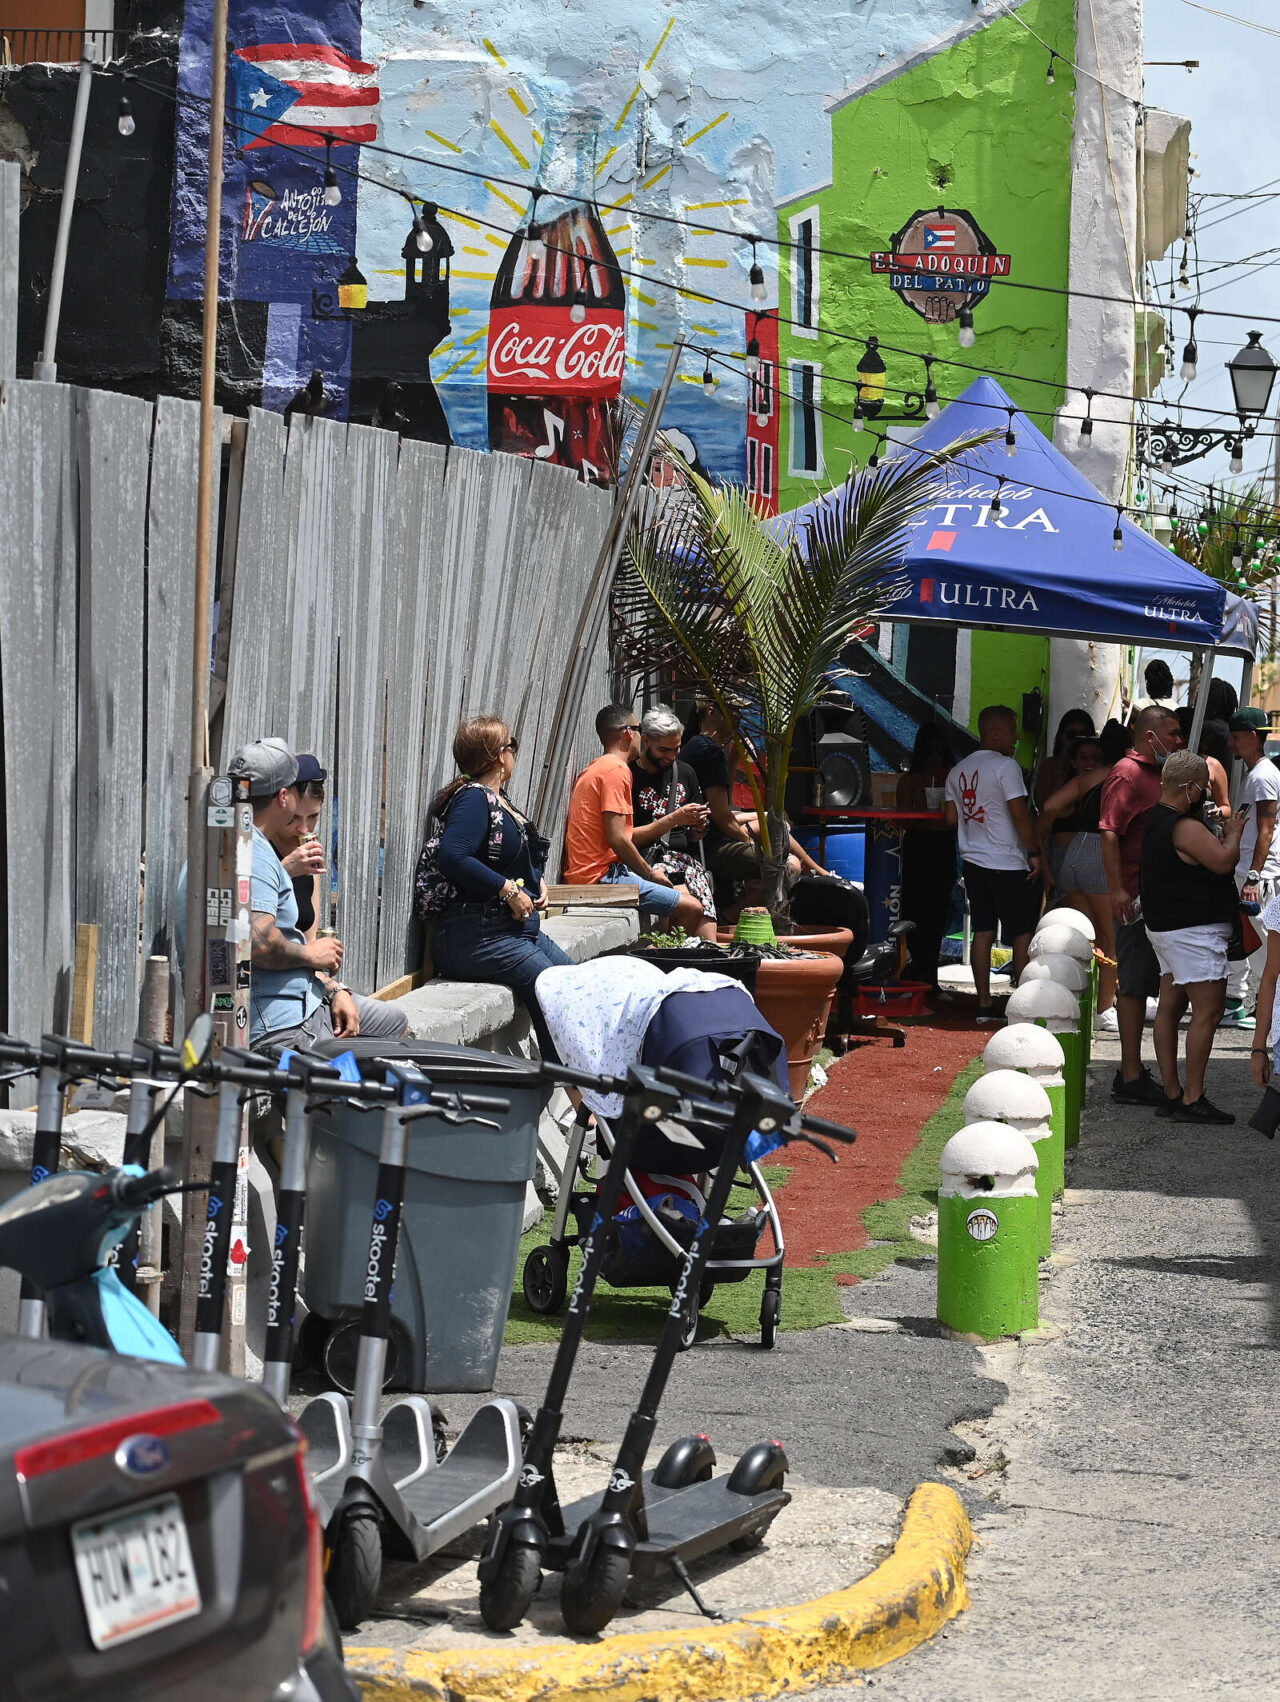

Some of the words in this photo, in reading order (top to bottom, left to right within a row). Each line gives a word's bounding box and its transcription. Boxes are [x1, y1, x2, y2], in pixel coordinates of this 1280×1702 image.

[288, 211, 305, 221] DEL
[874, 253, 899, 270] EL
[915, 255, 1006, 274] ADOQUIN
[893, 275, 923, 289] DEL
[935, 276, 985, 292] PATO
[900, 504, 1060, 534] TRA
[940, 582, 1040, 612] ULTRA
[1153, 595, 1197, 608] Michelob
[1144, 605, 1204, 623] ULTRA
[197, 1220, 218, 1298] skootel
[364, 1222, 388, 1303] skootel
[267, 1248, 286, 1328] skootel
[568, 1236, 595, 1314] skootel
[668, 1240, 700, 1319] skootel
